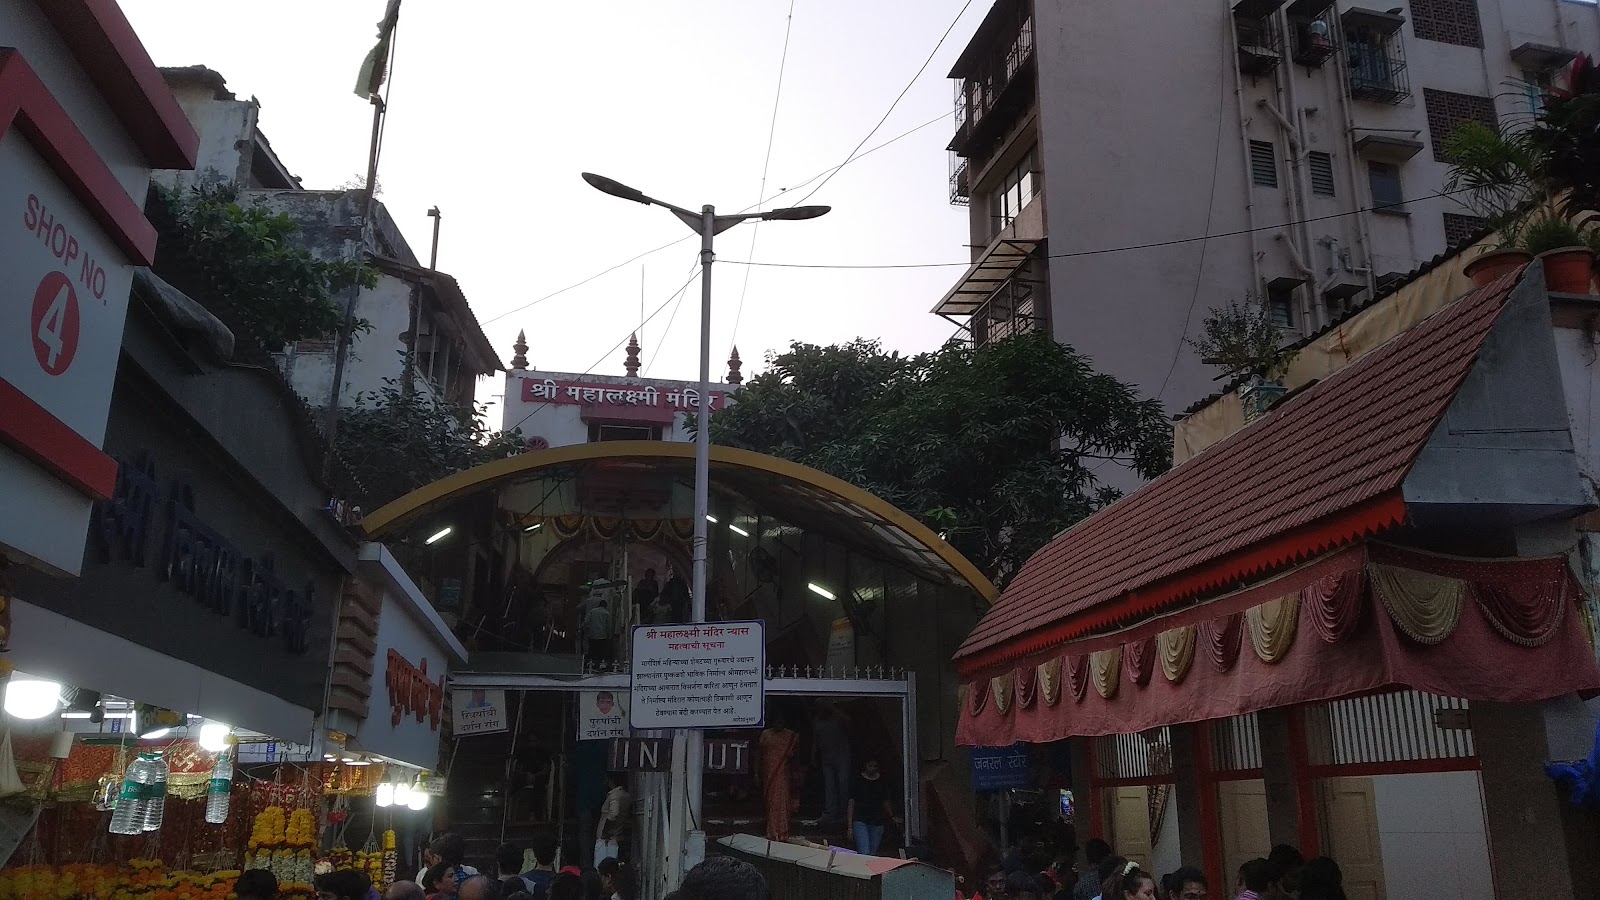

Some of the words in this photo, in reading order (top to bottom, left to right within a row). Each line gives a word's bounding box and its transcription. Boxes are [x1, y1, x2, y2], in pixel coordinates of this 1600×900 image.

[24, 193, 79, 266] SHOP
[80, 251, 107, 306] NO.
[37, 283, 69, 369] 4
[530, 379, 559, 400] श्री
[566, 384, 660, 408] महालक्ष्मी
[646, 628, 657, 640] श्री
[659, 626, 701, 640] महालक्ष्मी
[703, 627, 725, 638] मंदिर
[727, 627, 750, 636] न्यास
[668, 640, 701, 651] महत्वाची
[703, 641, 725, 651] सूचना
[586, 727, 608, 738] दर्शन
[708, 740, 750, 770] UT
[973, 755, 1002, 771] जनरल
